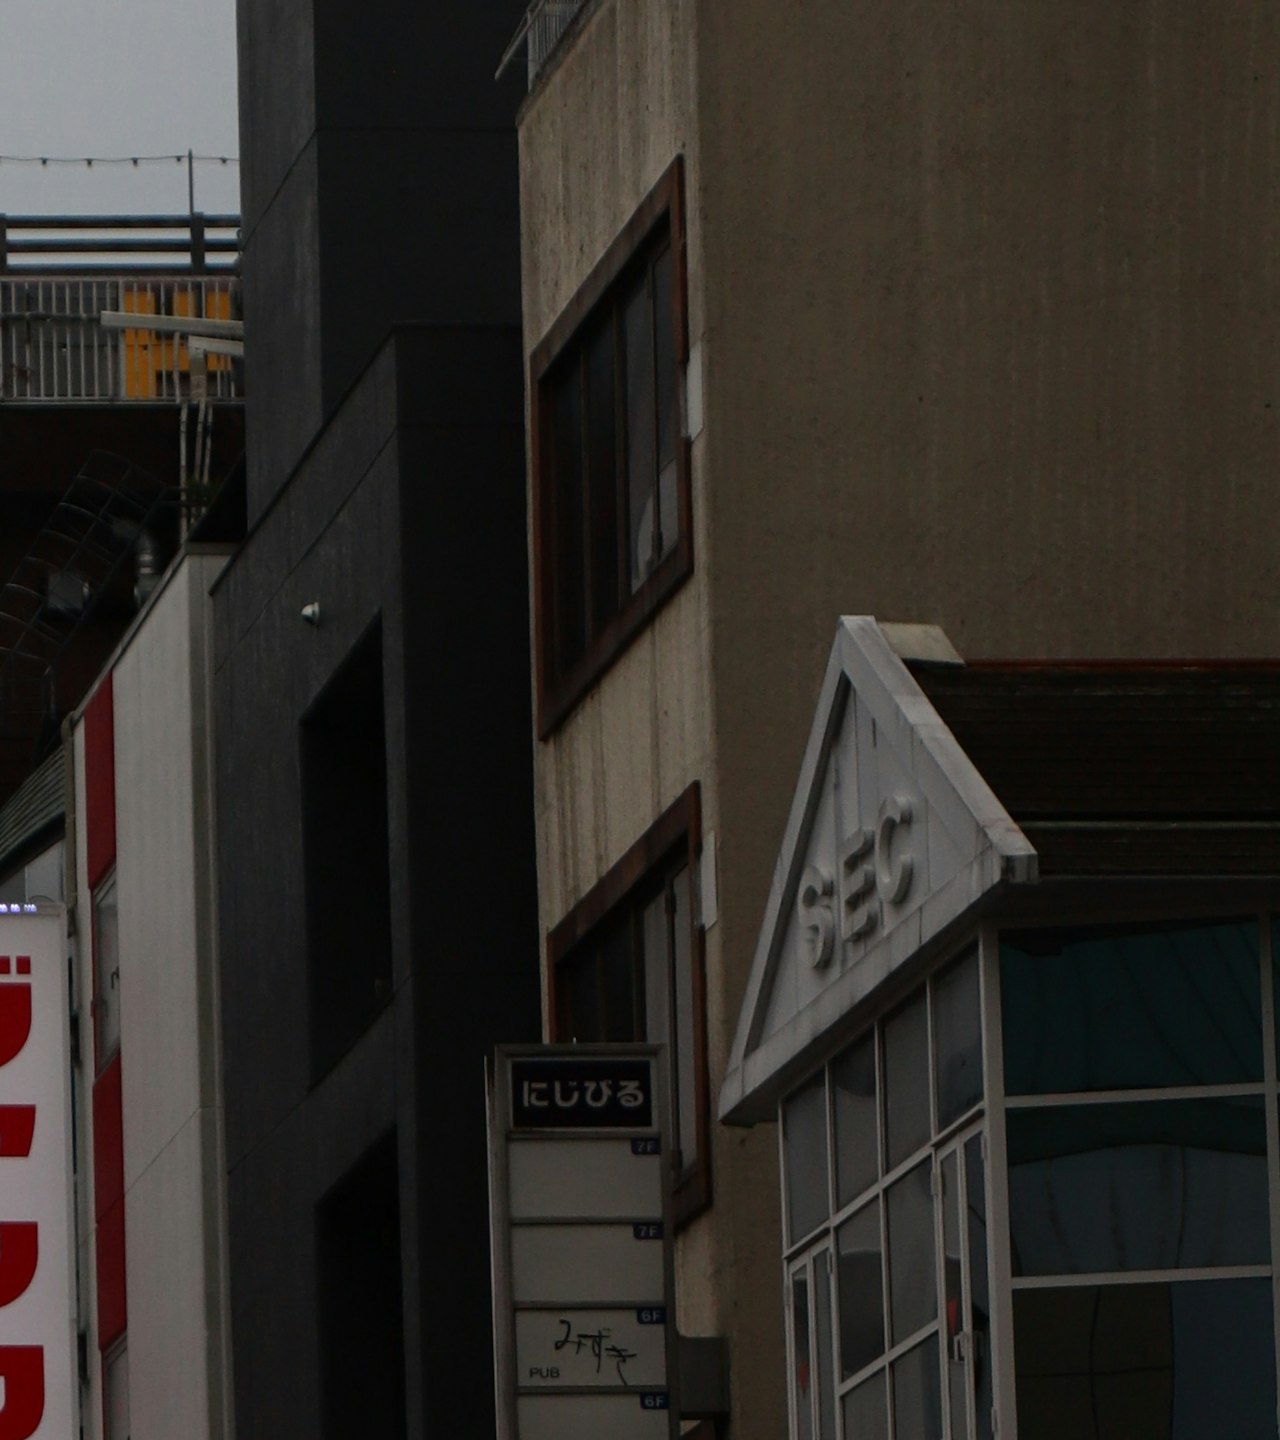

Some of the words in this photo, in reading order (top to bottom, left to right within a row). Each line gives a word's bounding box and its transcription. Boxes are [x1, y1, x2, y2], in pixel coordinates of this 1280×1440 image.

[797, 793, 916, 971] SEC
[522, 1079, 645, 1108] にじびる
[636, 1140, 656, 1152] 7F
[639, 1224, 658, 1237] 7F
[641, 1310, 661, 1322] 6F
[529, 1367, 560, 1379] PUB
[643, 1396, 665, 1407] 6F
